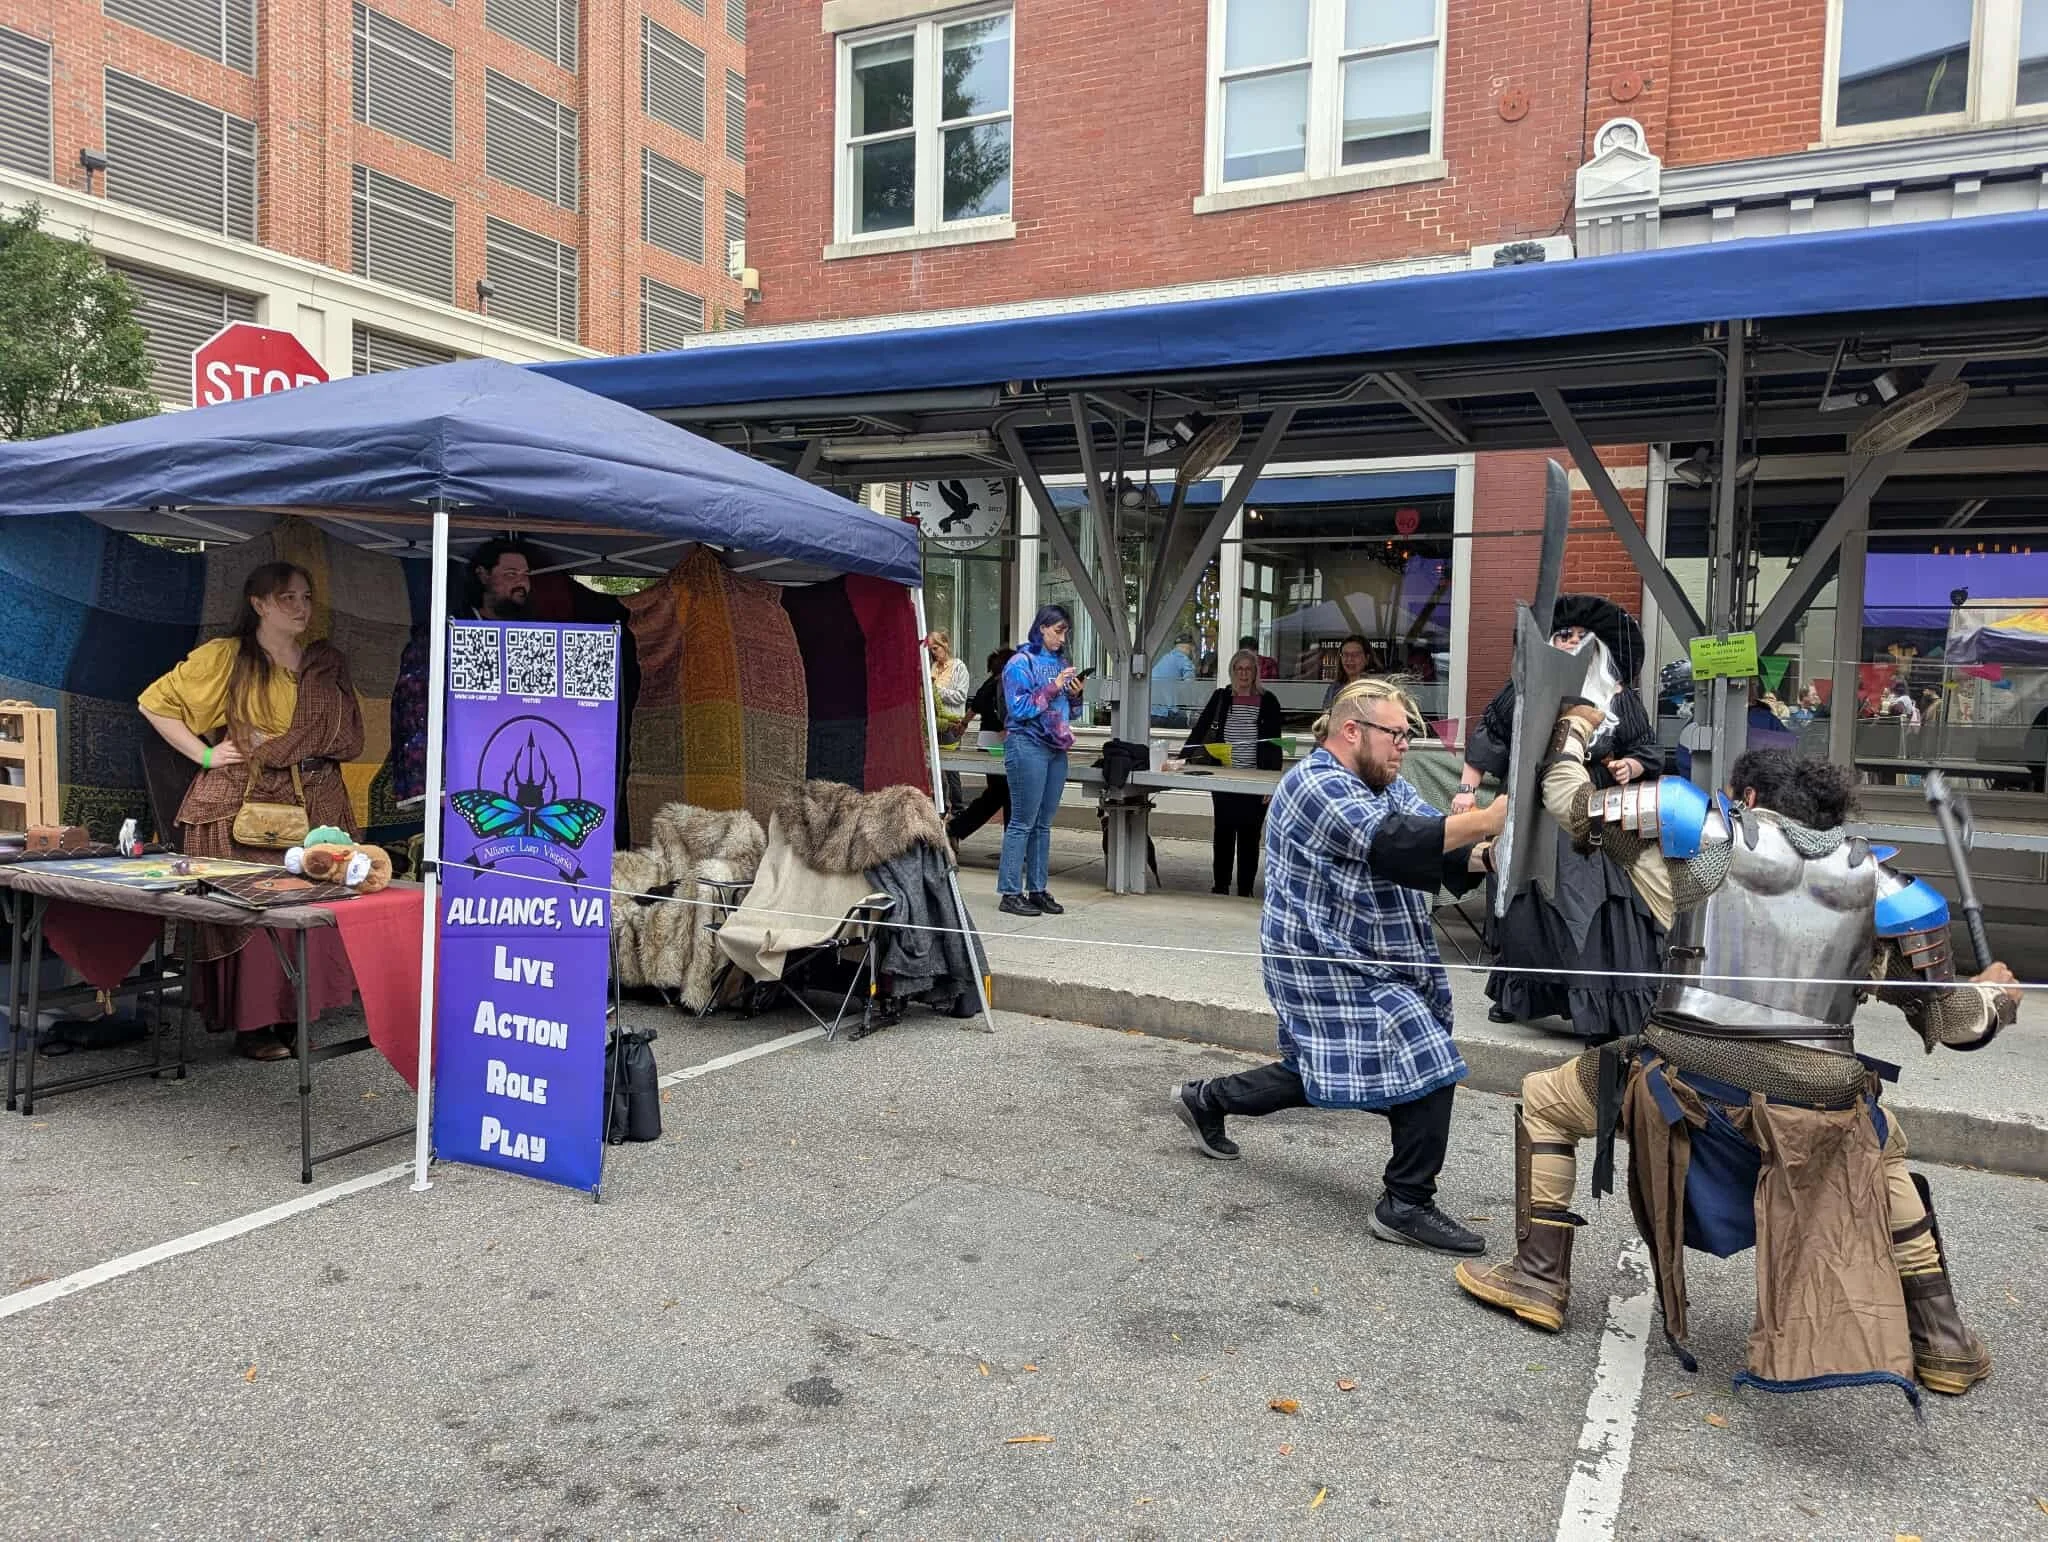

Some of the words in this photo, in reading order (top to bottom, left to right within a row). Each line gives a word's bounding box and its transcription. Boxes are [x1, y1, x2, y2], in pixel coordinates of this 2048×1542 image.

[484, 844, 516, 859] Alliance
[519, 837, 539, 855] Larp
[543, 844, 573, 870] Virginia
[446, 896, 563, 930] ALLIANCE,
[569, 897, 605, 928] VA
